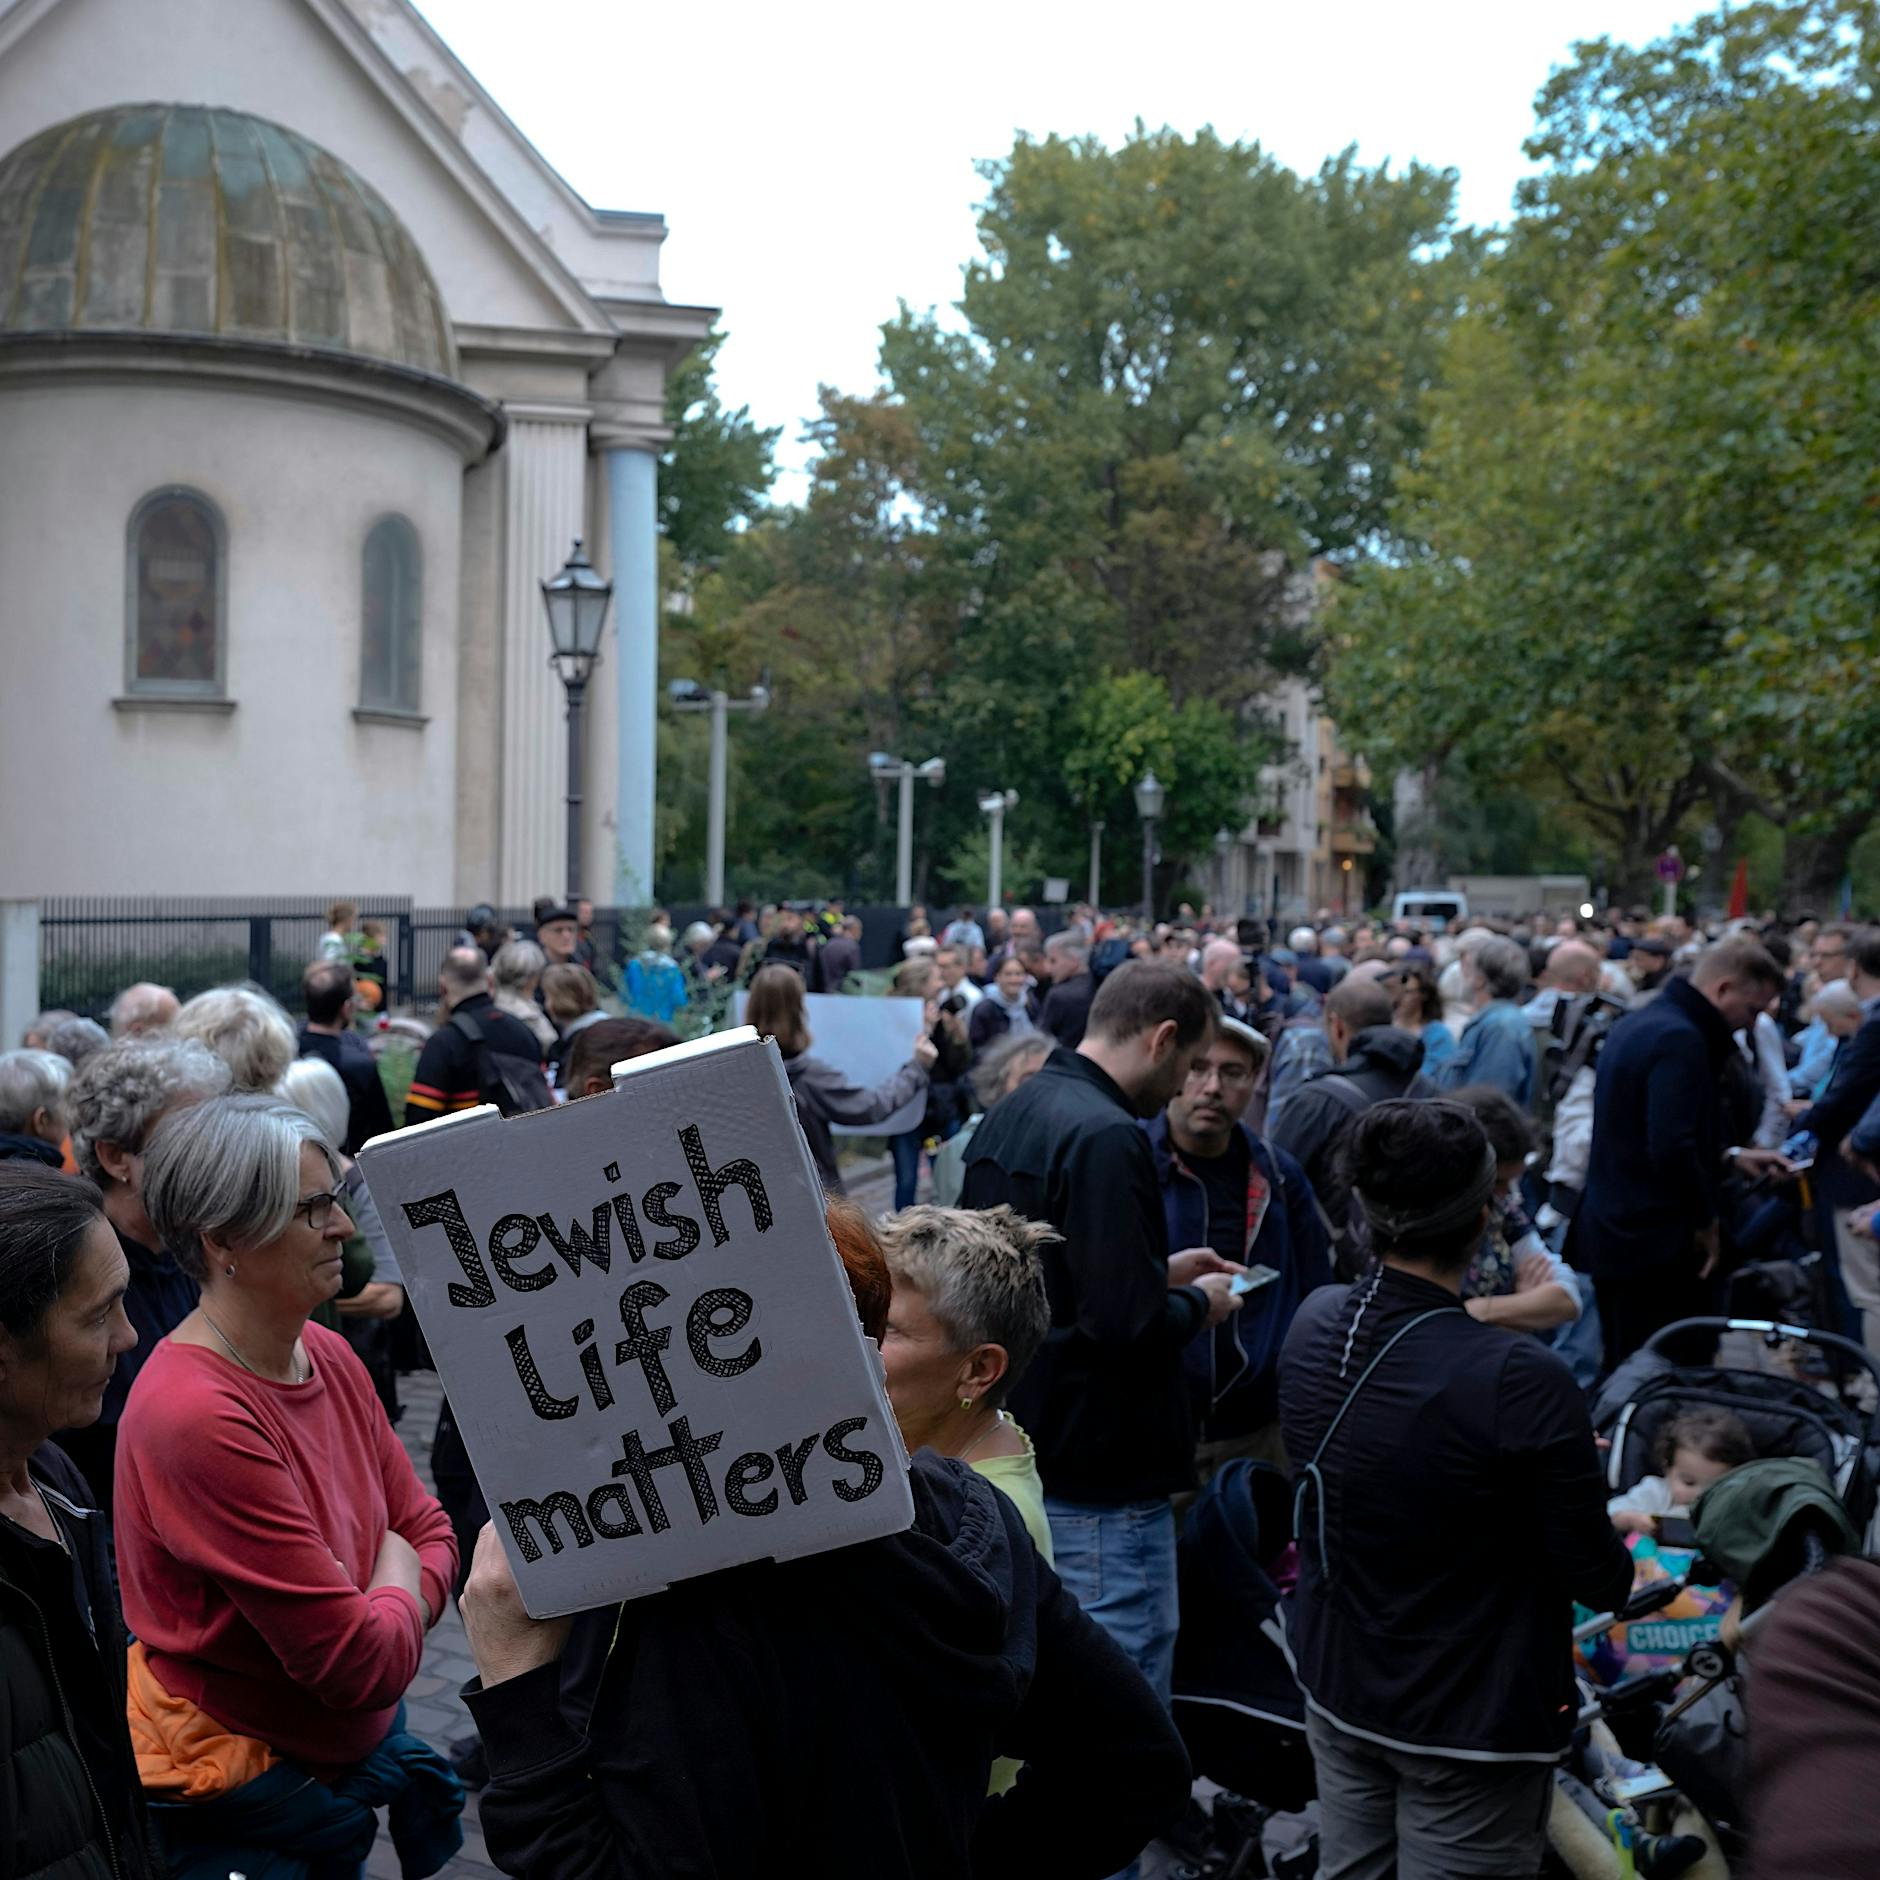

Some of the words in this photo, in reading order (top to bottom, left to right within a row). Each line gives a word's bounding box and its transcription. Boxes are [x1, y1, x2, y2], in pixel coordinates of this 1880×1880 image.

[400, 1124, 774, 1308] Jewish
[504, 1280, 763, 1420] Life
[498, 1416, 884, 1564] matters
